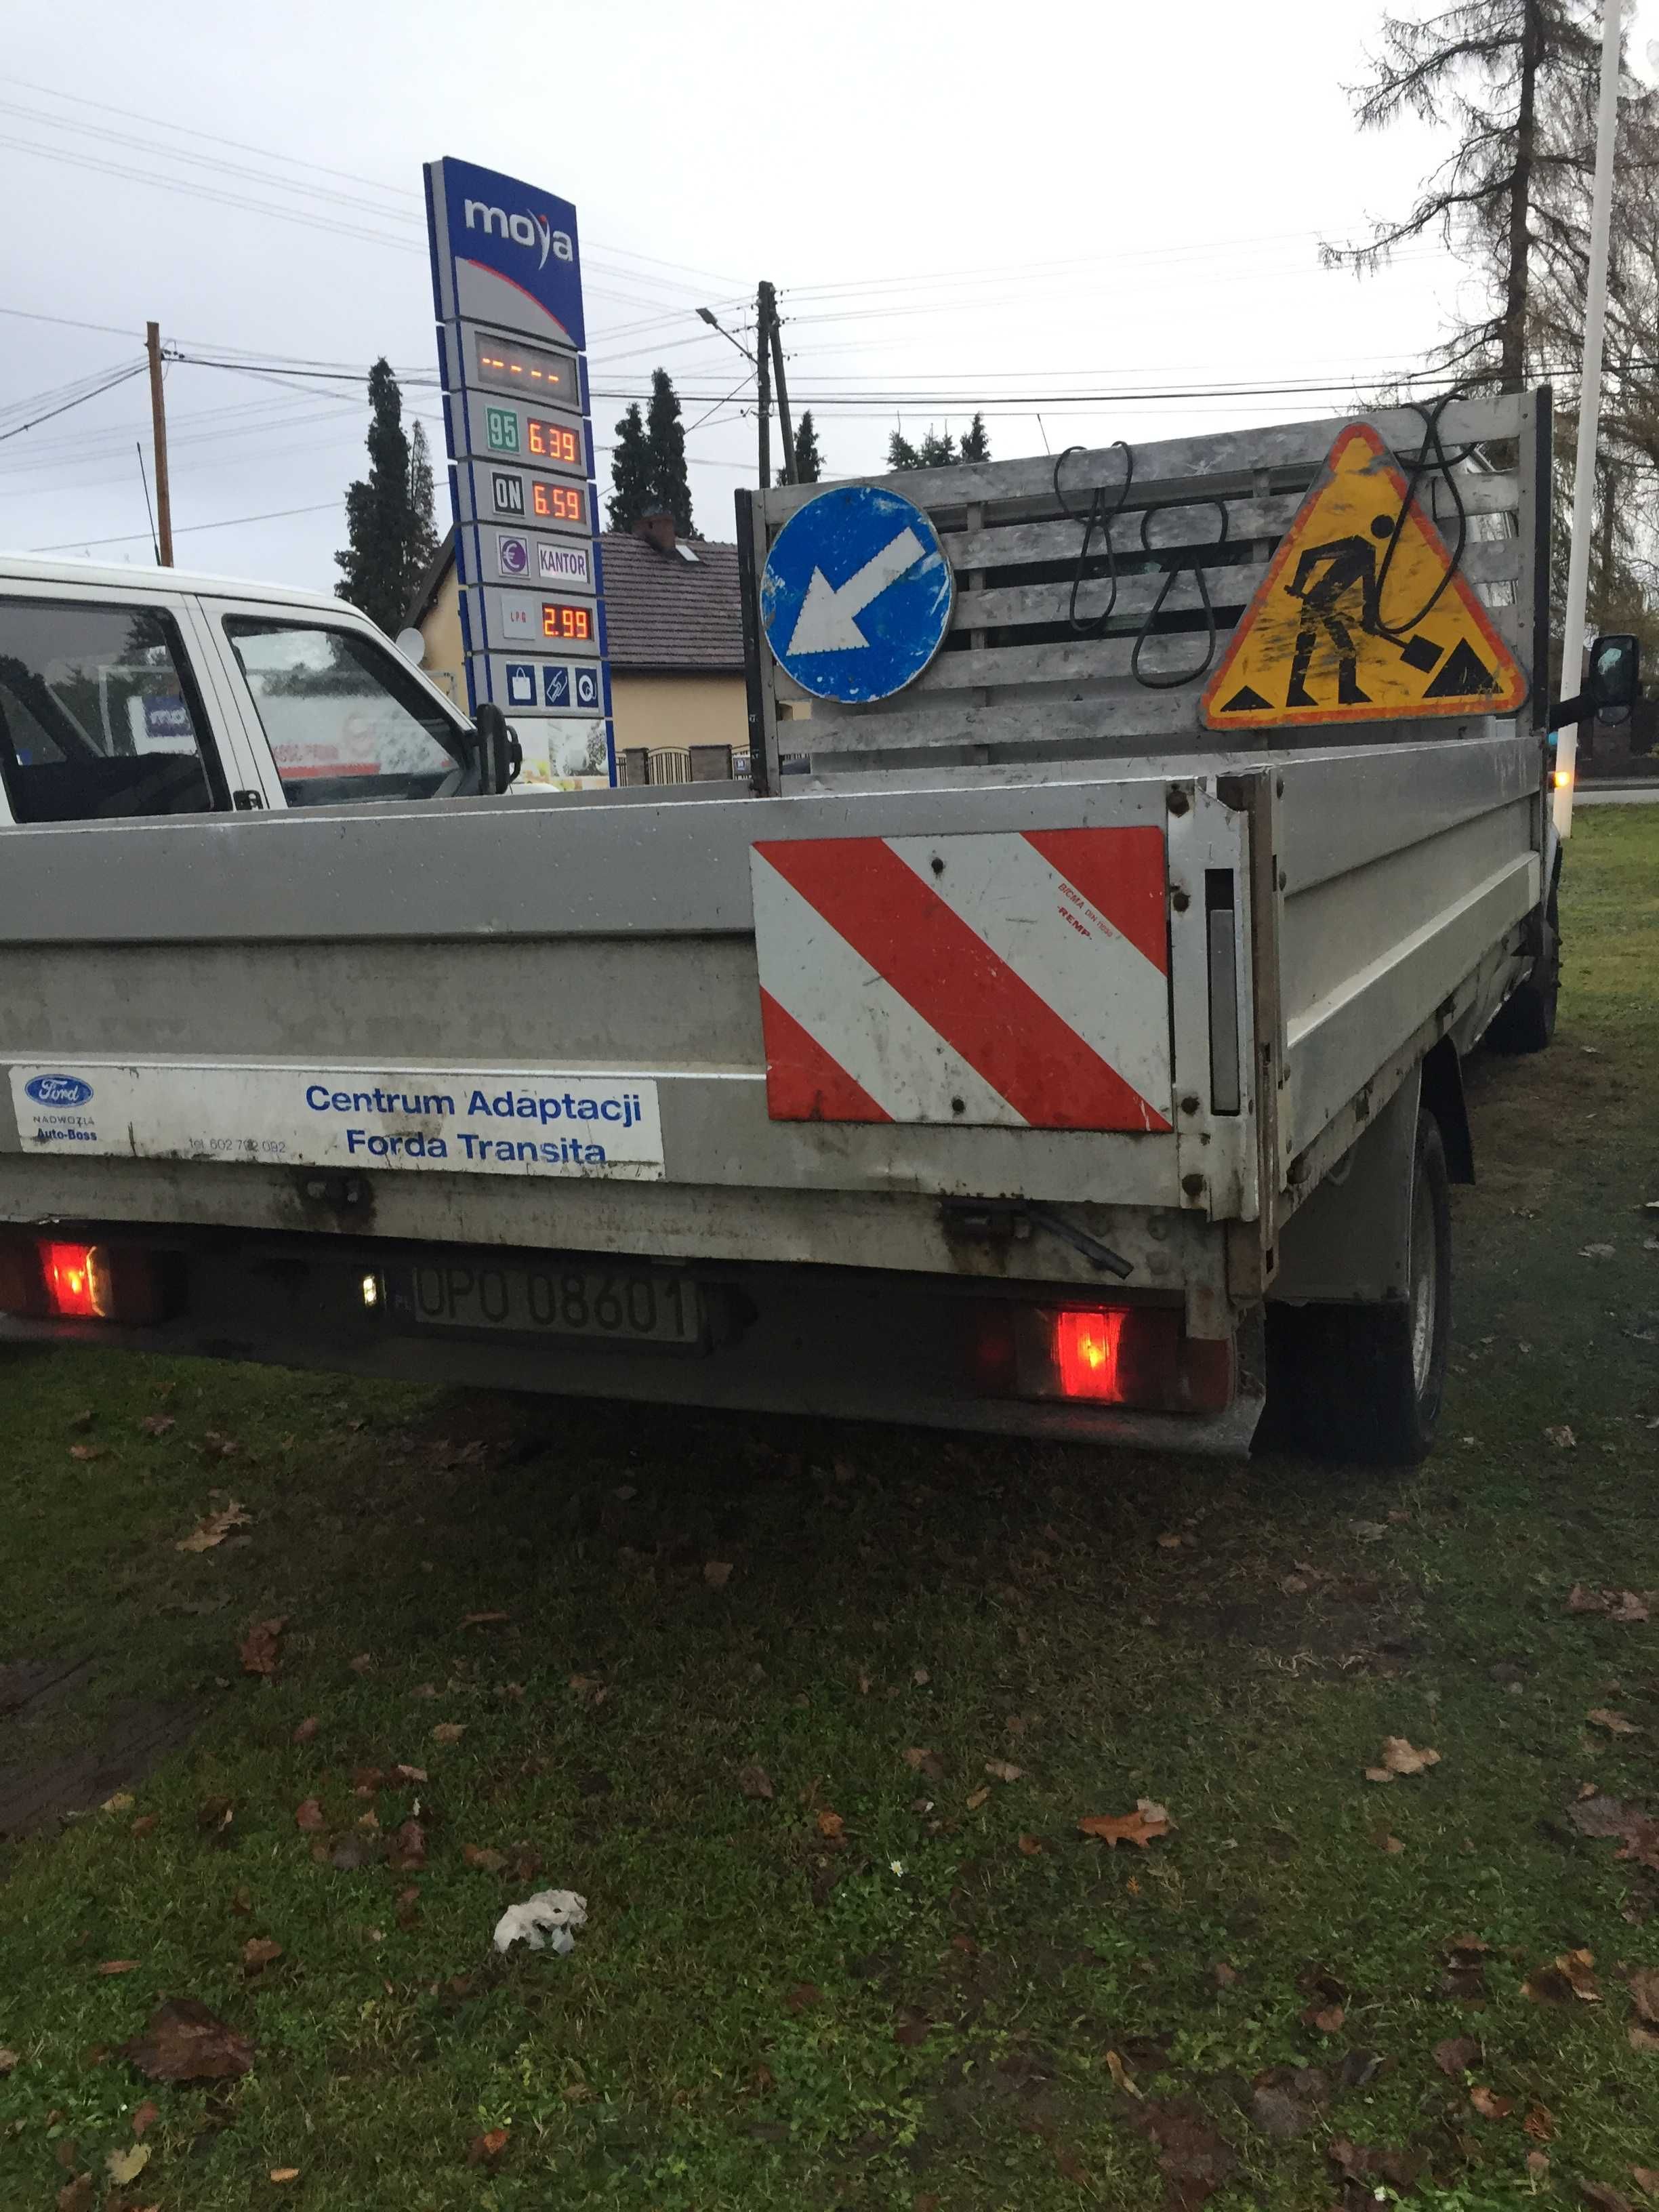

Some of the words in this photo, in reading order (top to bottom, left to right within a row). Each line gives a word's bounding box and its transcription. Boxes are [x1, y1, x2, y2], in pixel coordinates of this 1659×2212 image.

[464, 199, 574, 270] moya
[490, 409, 516, 450] 95
[529, 424, 575, 462] 6.39
[495, 478, 522, 511] ON
[533, 484, 579, 520] 6.59
[540, 549, 586, 577] KANTOR
[510, 611, 527, 623] LPG
[543, 607, 588, 639] 2.99
[1084, 909, 1098, 922] DIN
[39, 1078, 80, 1102] Ford
[306, 1085, 455, 1116] Centrum
[468, 1090, 641, 1127] Adaptacji
[37, 1127, 98, 1141] Auto-Boss
[210, 1139, 233, 1151] 602
[346, 1129, 448, 1159] Forda
[457, 1133, 607, 1164] Transita
[527, 1272, 687, 1336] 08601
